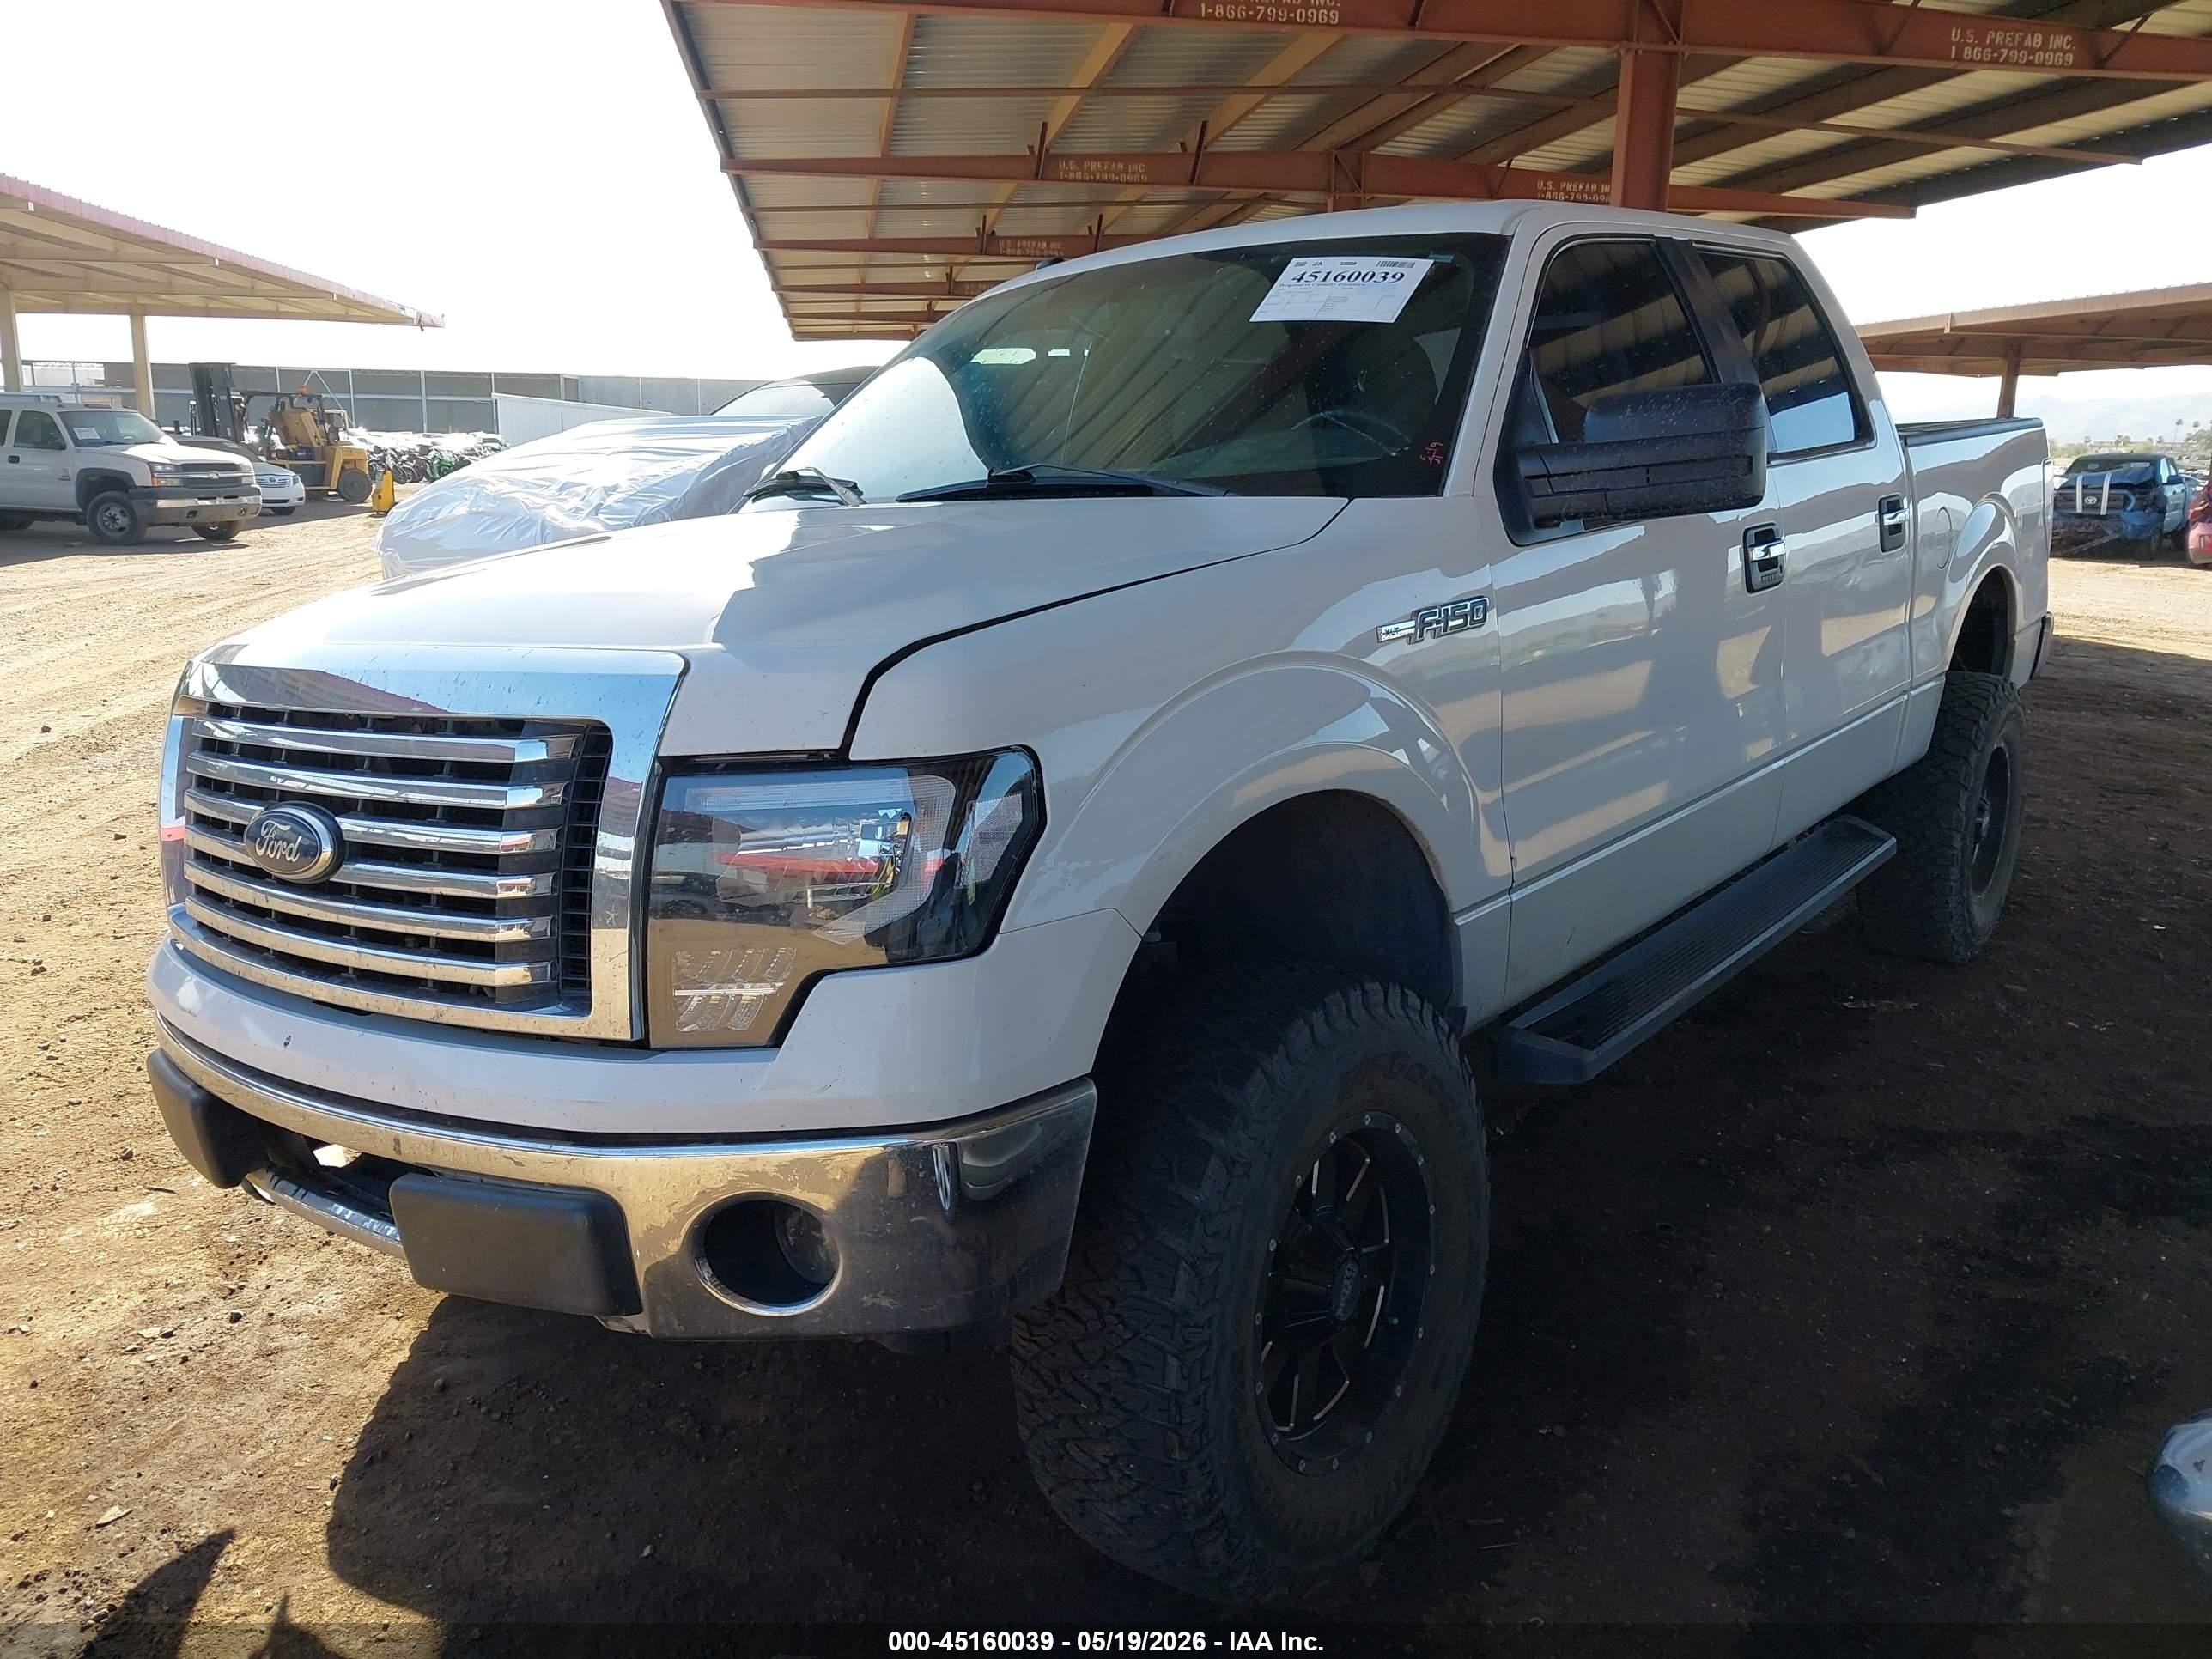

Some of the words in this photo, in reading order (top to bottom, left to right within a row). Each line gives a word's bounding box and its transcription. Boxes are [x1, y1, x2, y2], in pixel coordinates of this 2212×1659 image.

[1200, 3, 1340, 25] 1-866-799-0969
[1951, 27, 1978, 44] U.S.
[1986, 30, 2043, 48] PREFAB
[2049, 33, 2075, 50] INC.
[1963, 46, 2074, 67] 866-799-0969
[1084, 160, 1124, 173] PREFAB
[1537, 179, 1555, 191] U.S.
[1560, 181, 1597, 193] PREFAB
[1291, 270, 1406, 284] 45160039
[255, 819, 303, 863] Ford
